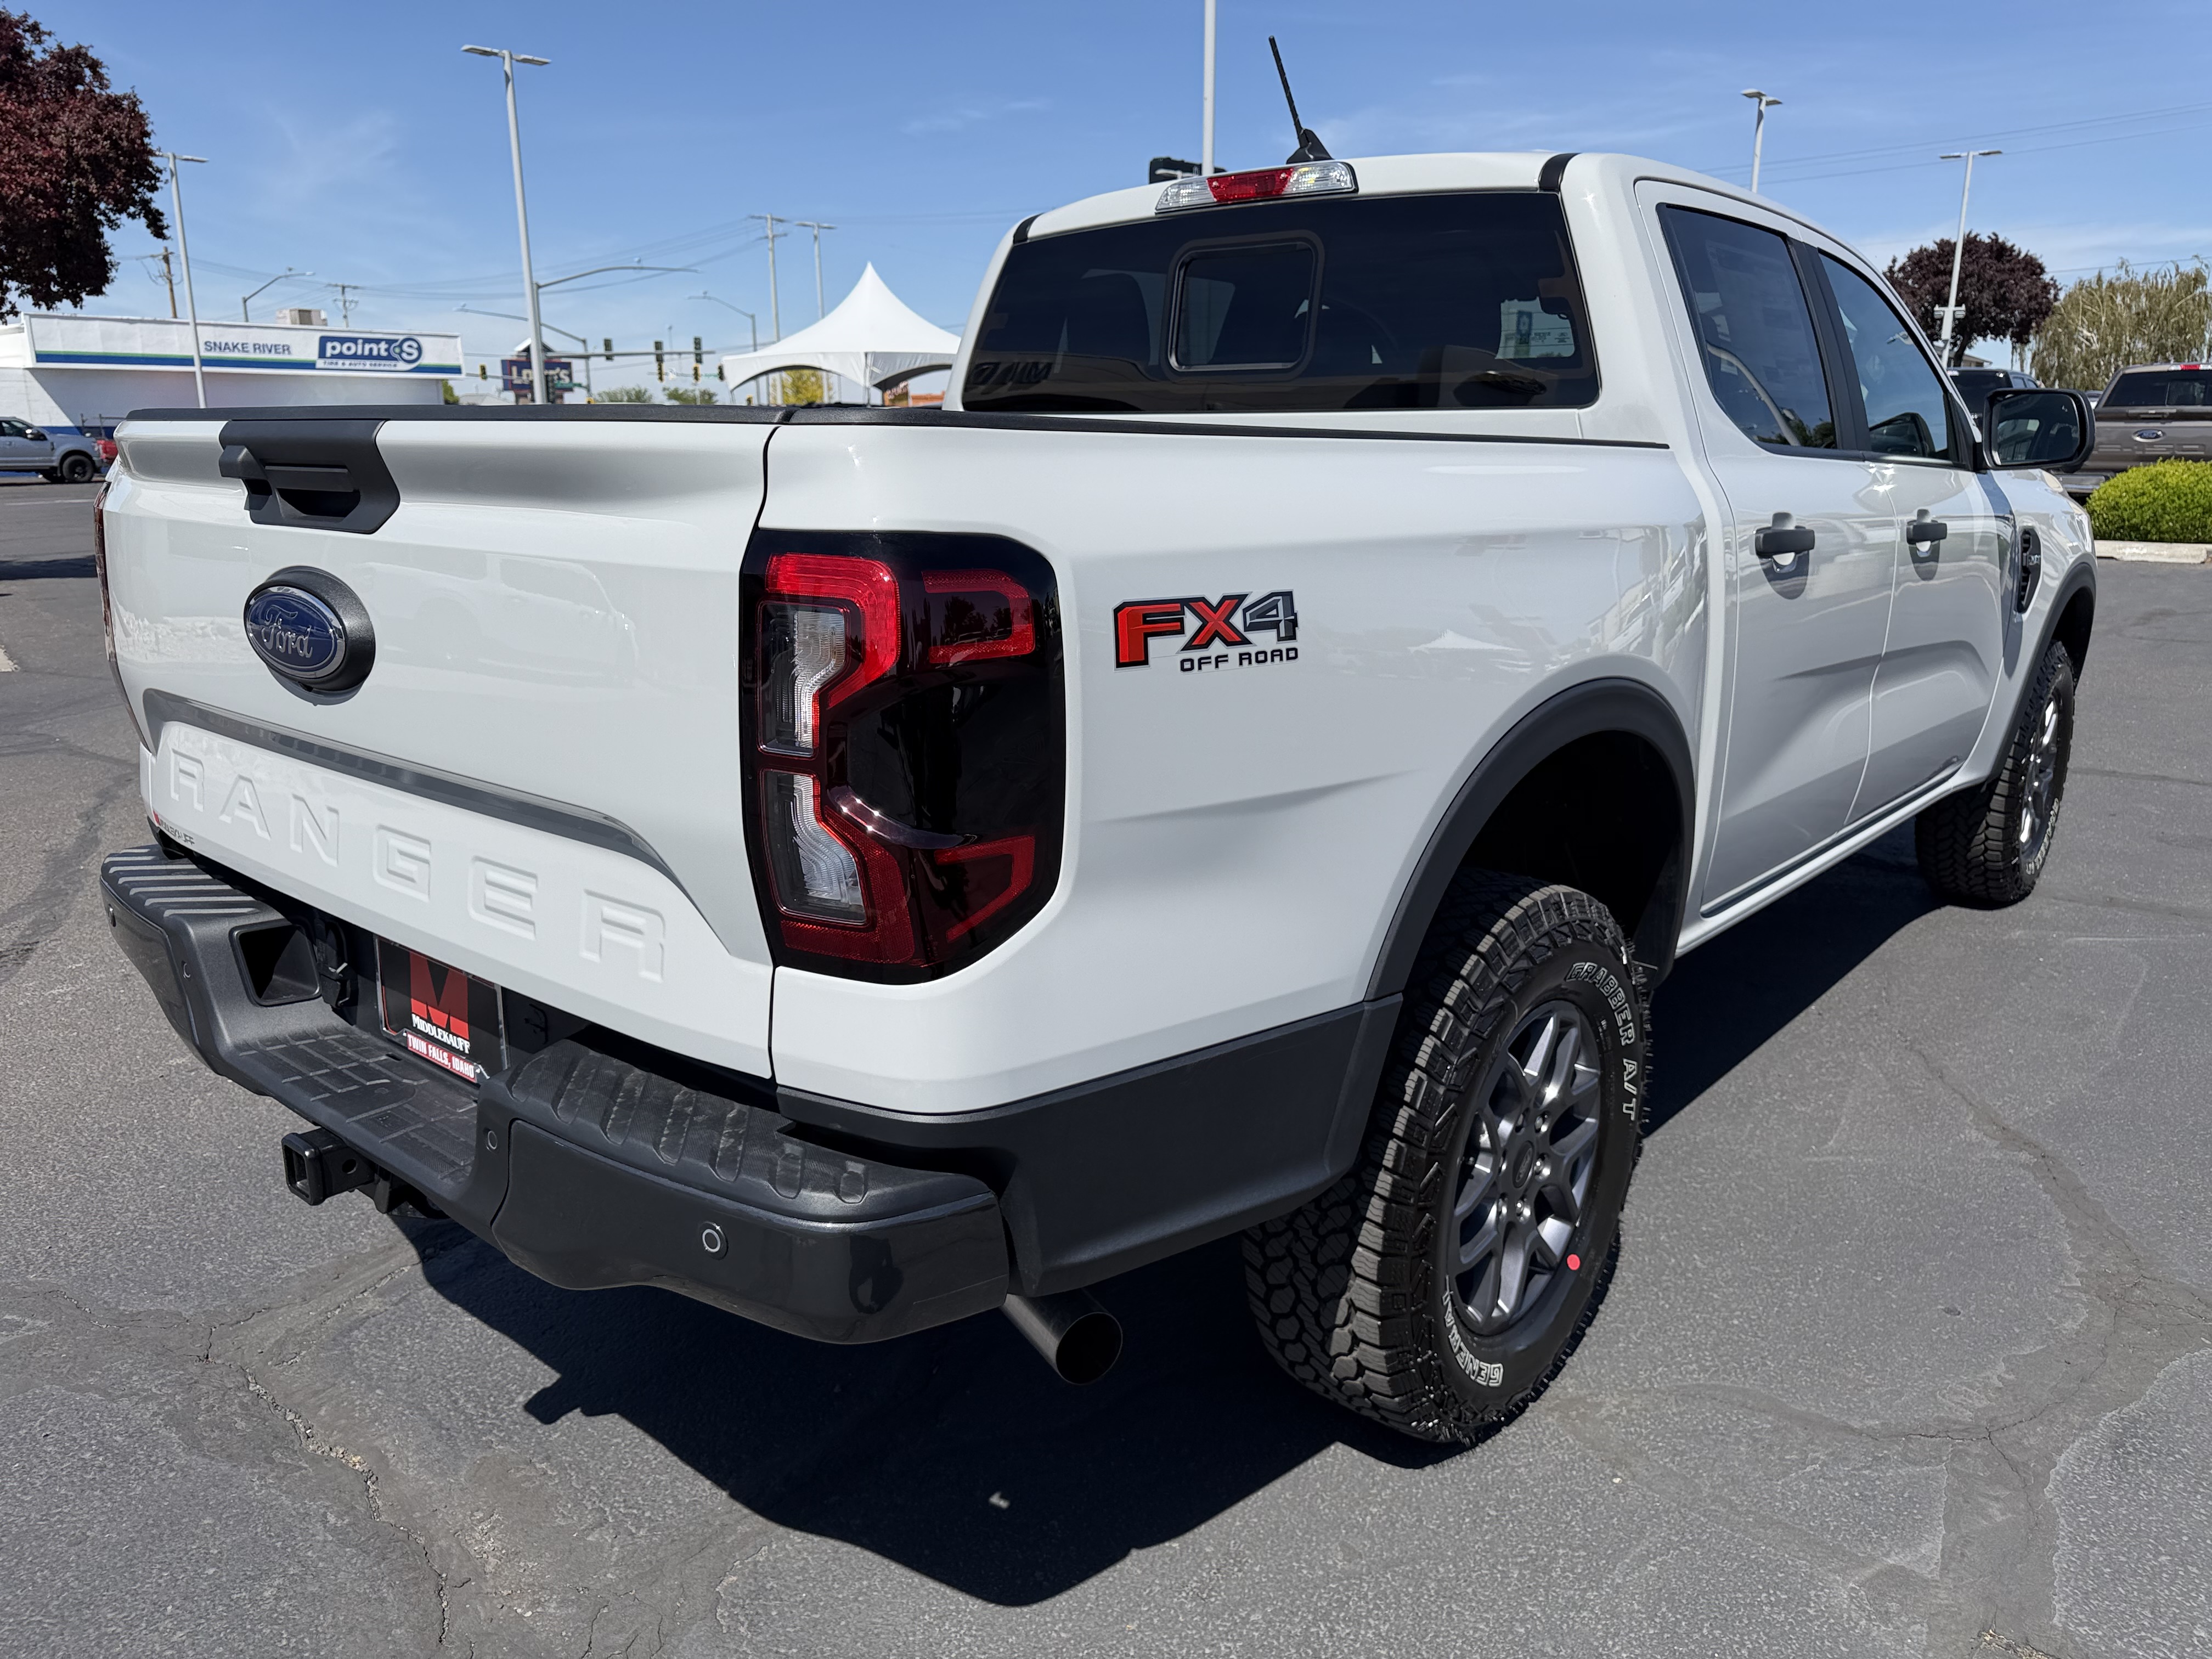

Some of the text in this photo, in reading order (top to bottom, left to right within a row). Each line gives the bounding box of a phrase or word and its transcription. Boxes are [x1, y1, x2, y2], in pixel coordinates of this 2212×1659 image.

[204, 340, 292, 355] SNAKE RIVER
[325, 338, 389, 358] point
[261, 605, 314, 658] Ford
[1113, 590, 1299, 669] FX4
[1180, 647, 1299, 673] OFF ROAD
[171, 748, 665, 983] RANGER
[411, 1013, 471, 1054] MIDDLEKAUFF
[1565, 962, 1637, 1046] GRABBER
[1622, 1057, 1638, 1121] A/T
[407, 1034, 475, 1079] TWIN FALLS, IDAHO
